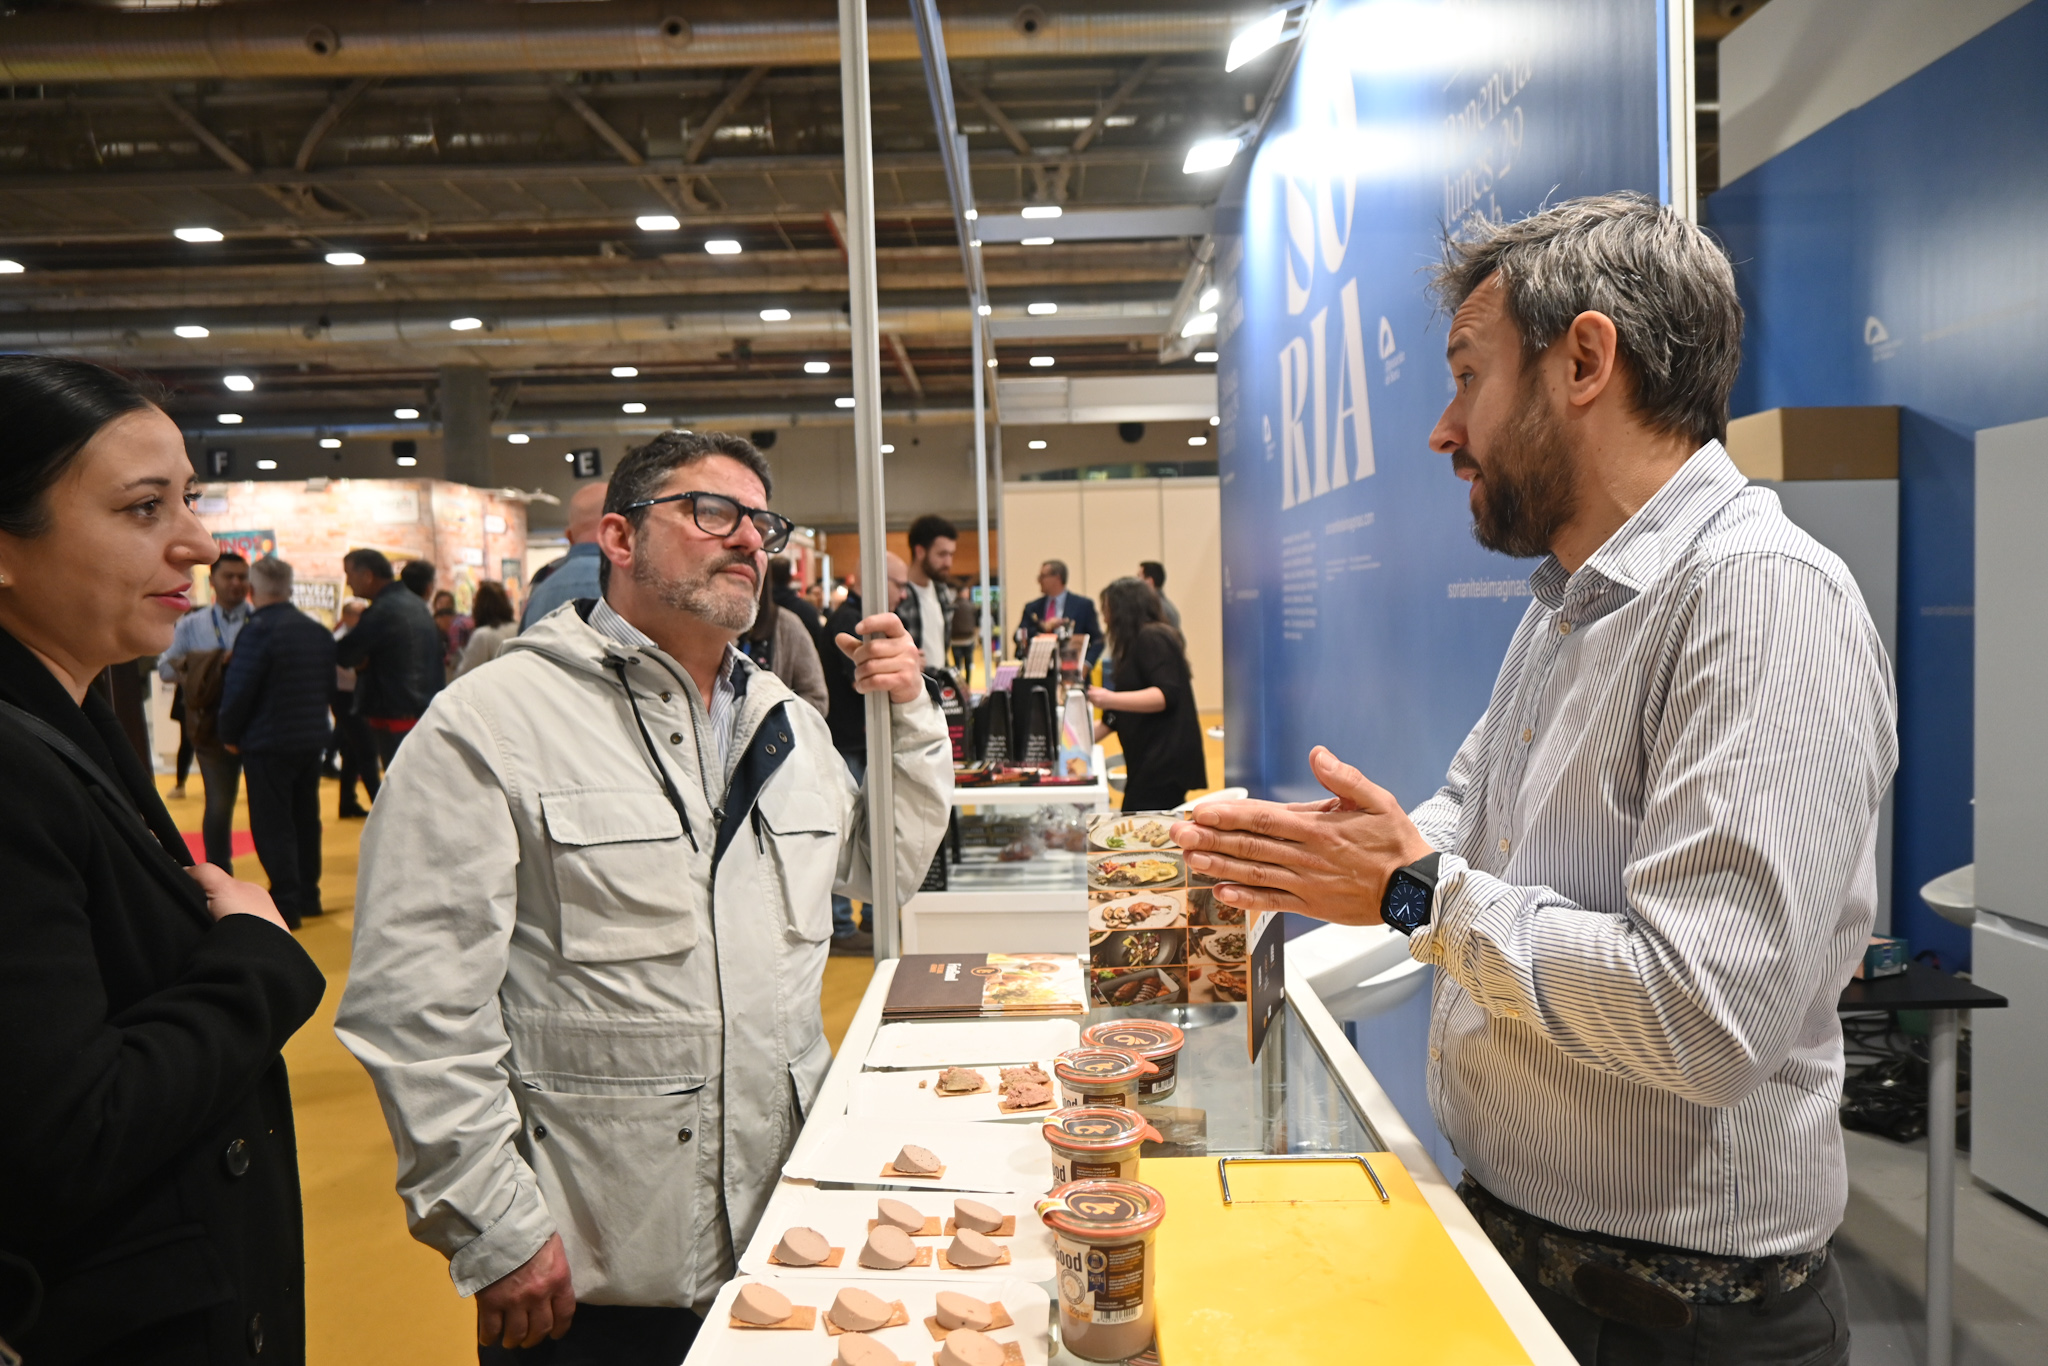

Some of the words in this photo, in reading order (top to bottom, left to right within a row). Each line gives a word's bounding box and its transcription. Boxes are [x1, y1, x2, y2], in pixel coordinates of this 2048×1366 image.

[1278, 276, 1377, 511] RIA
[215, 452, 228, 474] F
[579, 451, 595, 476] E
[291, 584, 335, 596] ERVEZA
